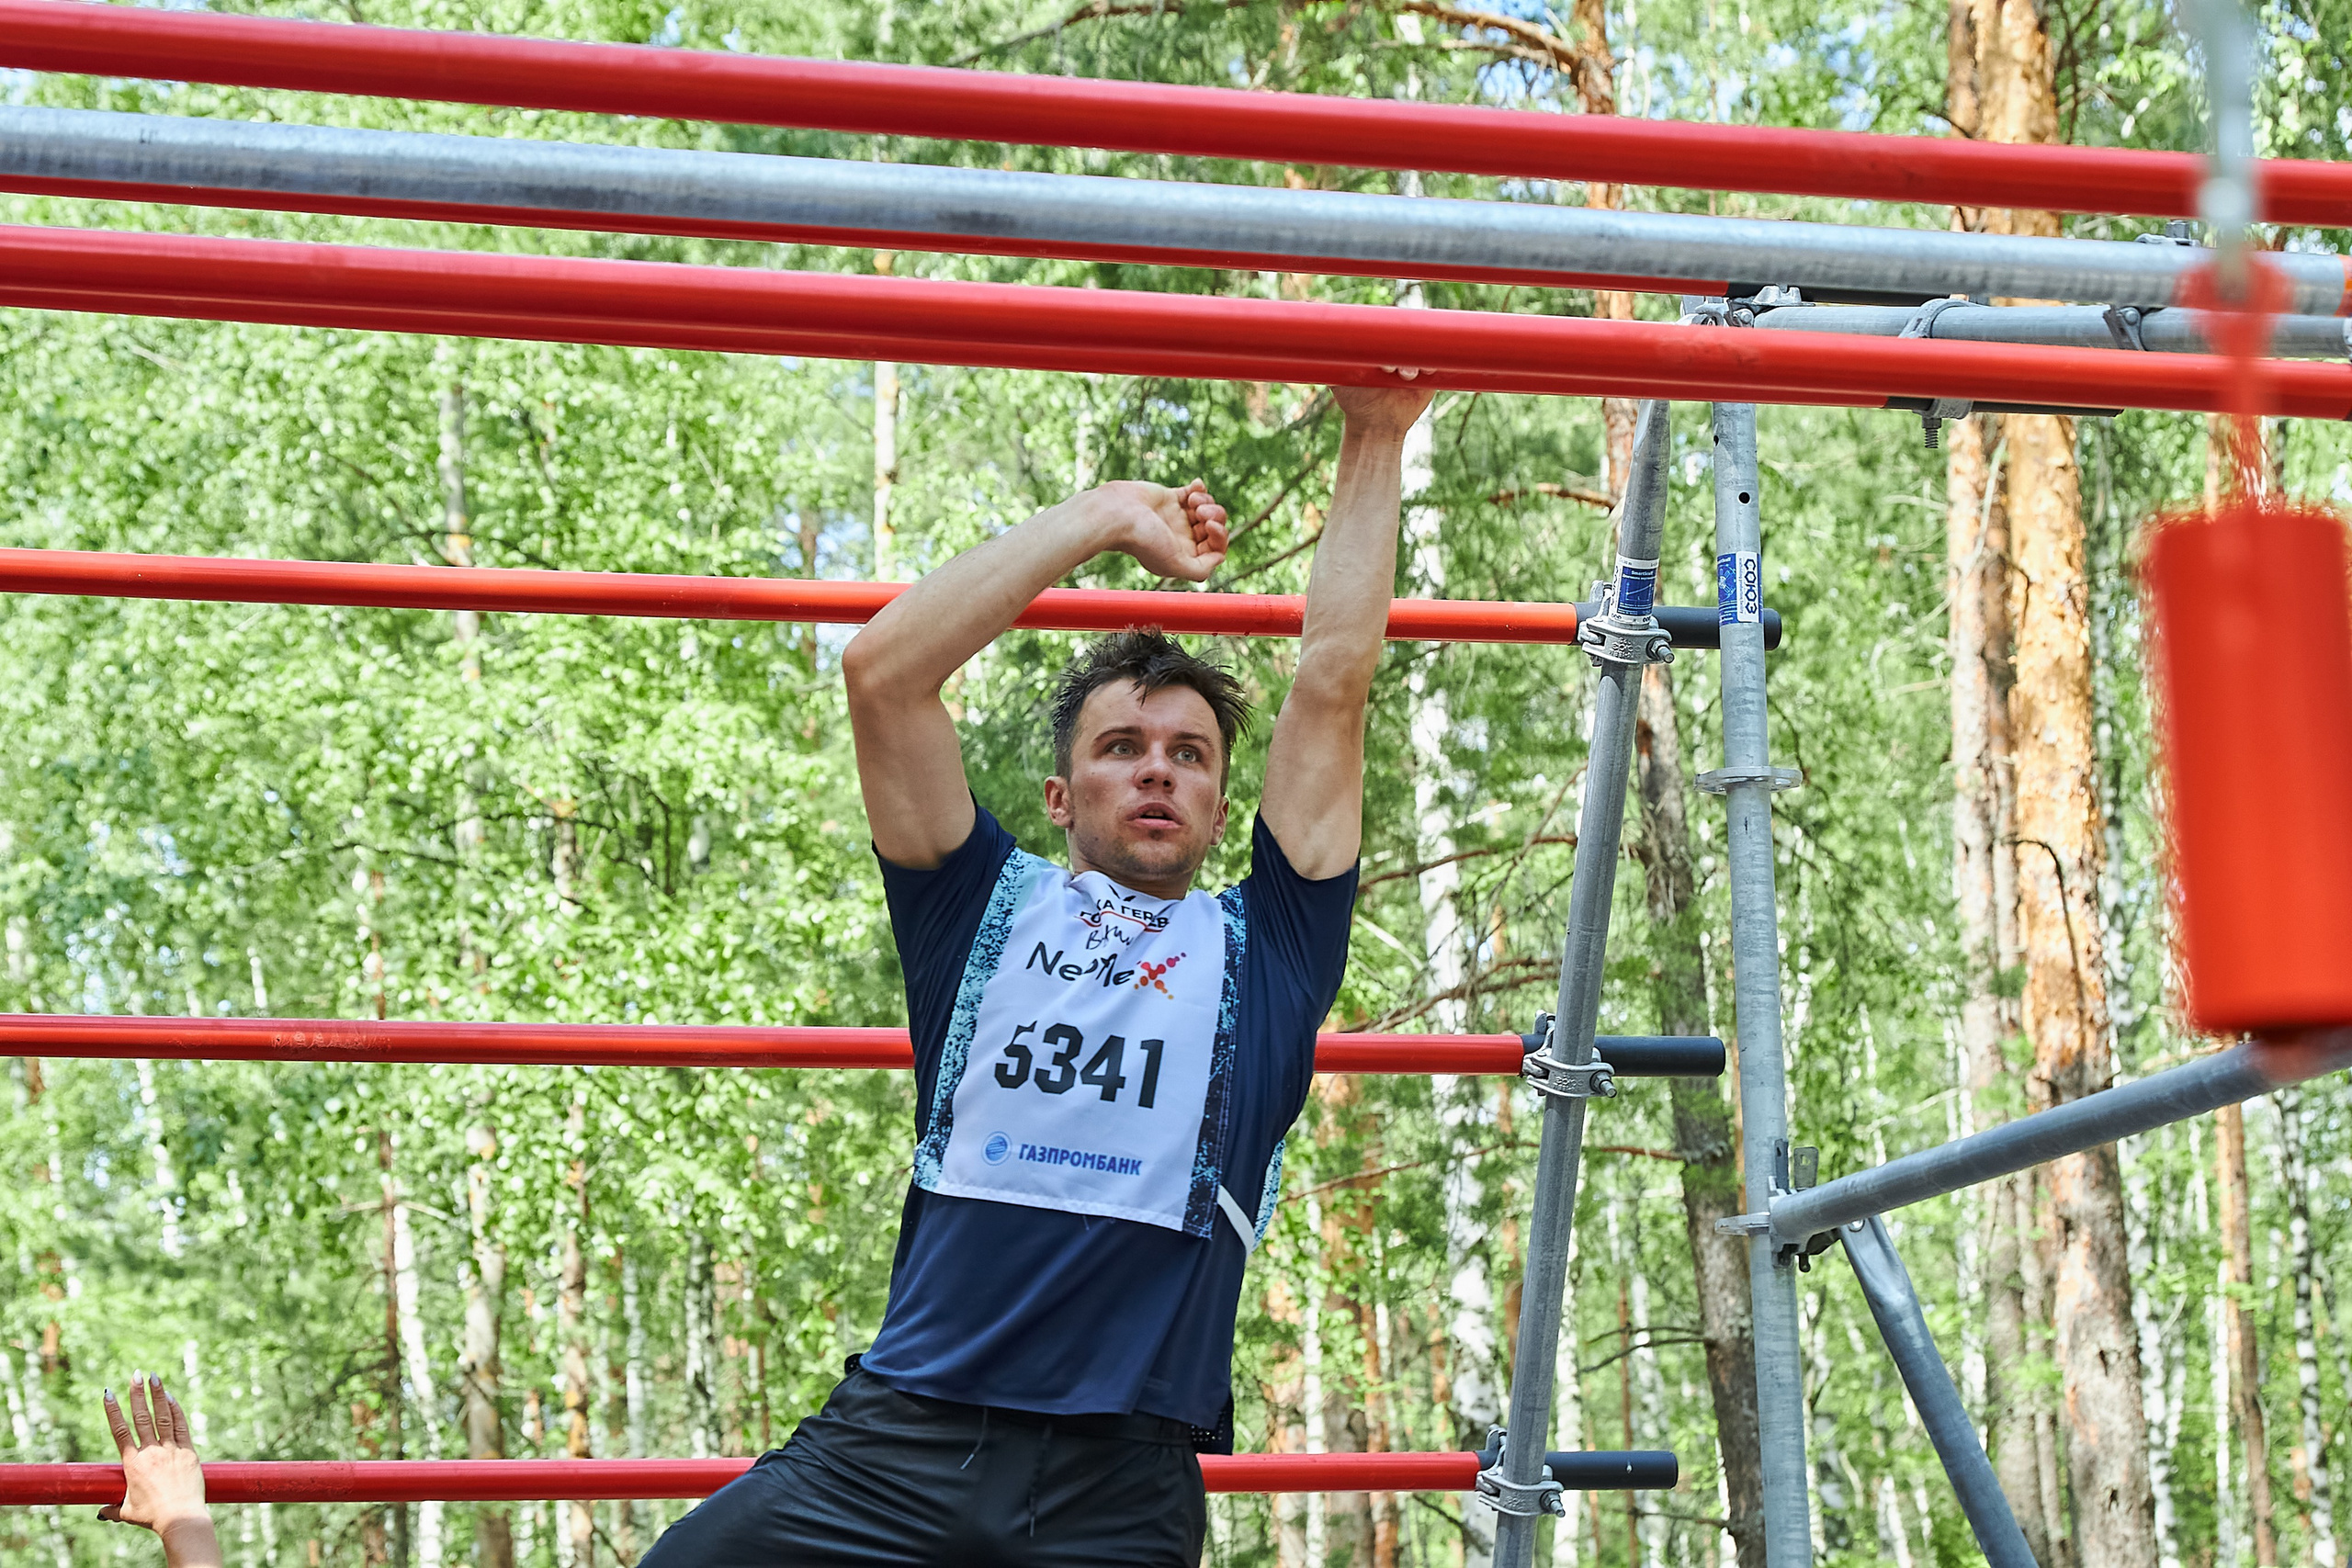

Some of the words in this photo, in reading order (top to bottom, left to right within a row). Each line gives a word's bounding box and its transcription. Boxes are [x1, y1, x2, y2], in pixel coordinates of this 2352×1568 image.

[1744, 558, 1757, 614] СОЮЗ
[994, 1020, 1165, 1110] 5341
[1018, 1144, 1144, 1177] ГАЗПРОМБАНК
